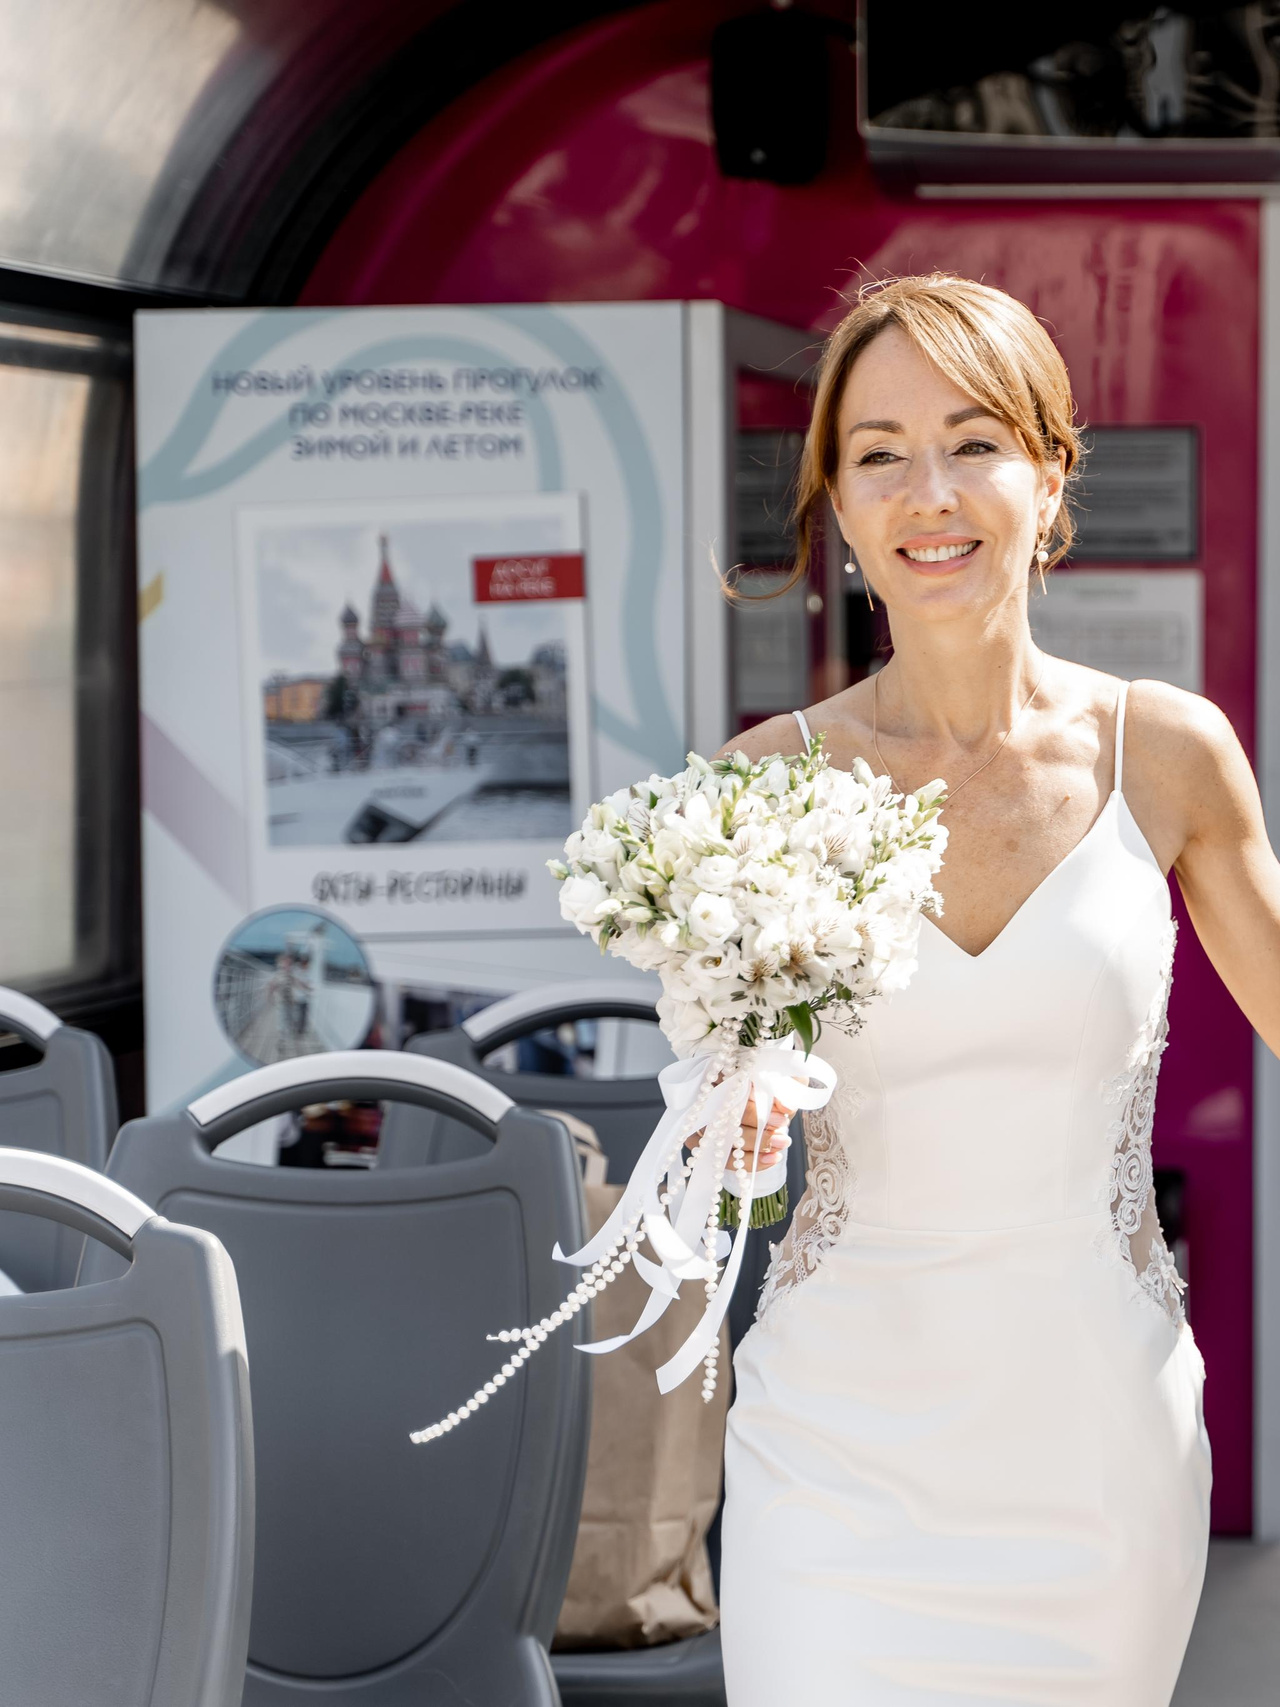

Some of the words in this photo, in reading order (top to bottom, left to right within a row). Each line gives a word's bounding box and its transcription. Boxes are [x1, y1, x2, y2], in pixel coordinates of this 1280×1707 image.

[212, 365, 314, 397] НОВЫЙ
[320, 368, 449, 400] УРОВЕНЬ
[452, 367, 605, 398] ПРОГУЛОК
[288, 402, 332, 428] ПО
[291, 429, 391, 461] ЗИМОЙ
[397, 434, 420, 460] И
[424, 432, 523, 460] ЛЕТОМ
